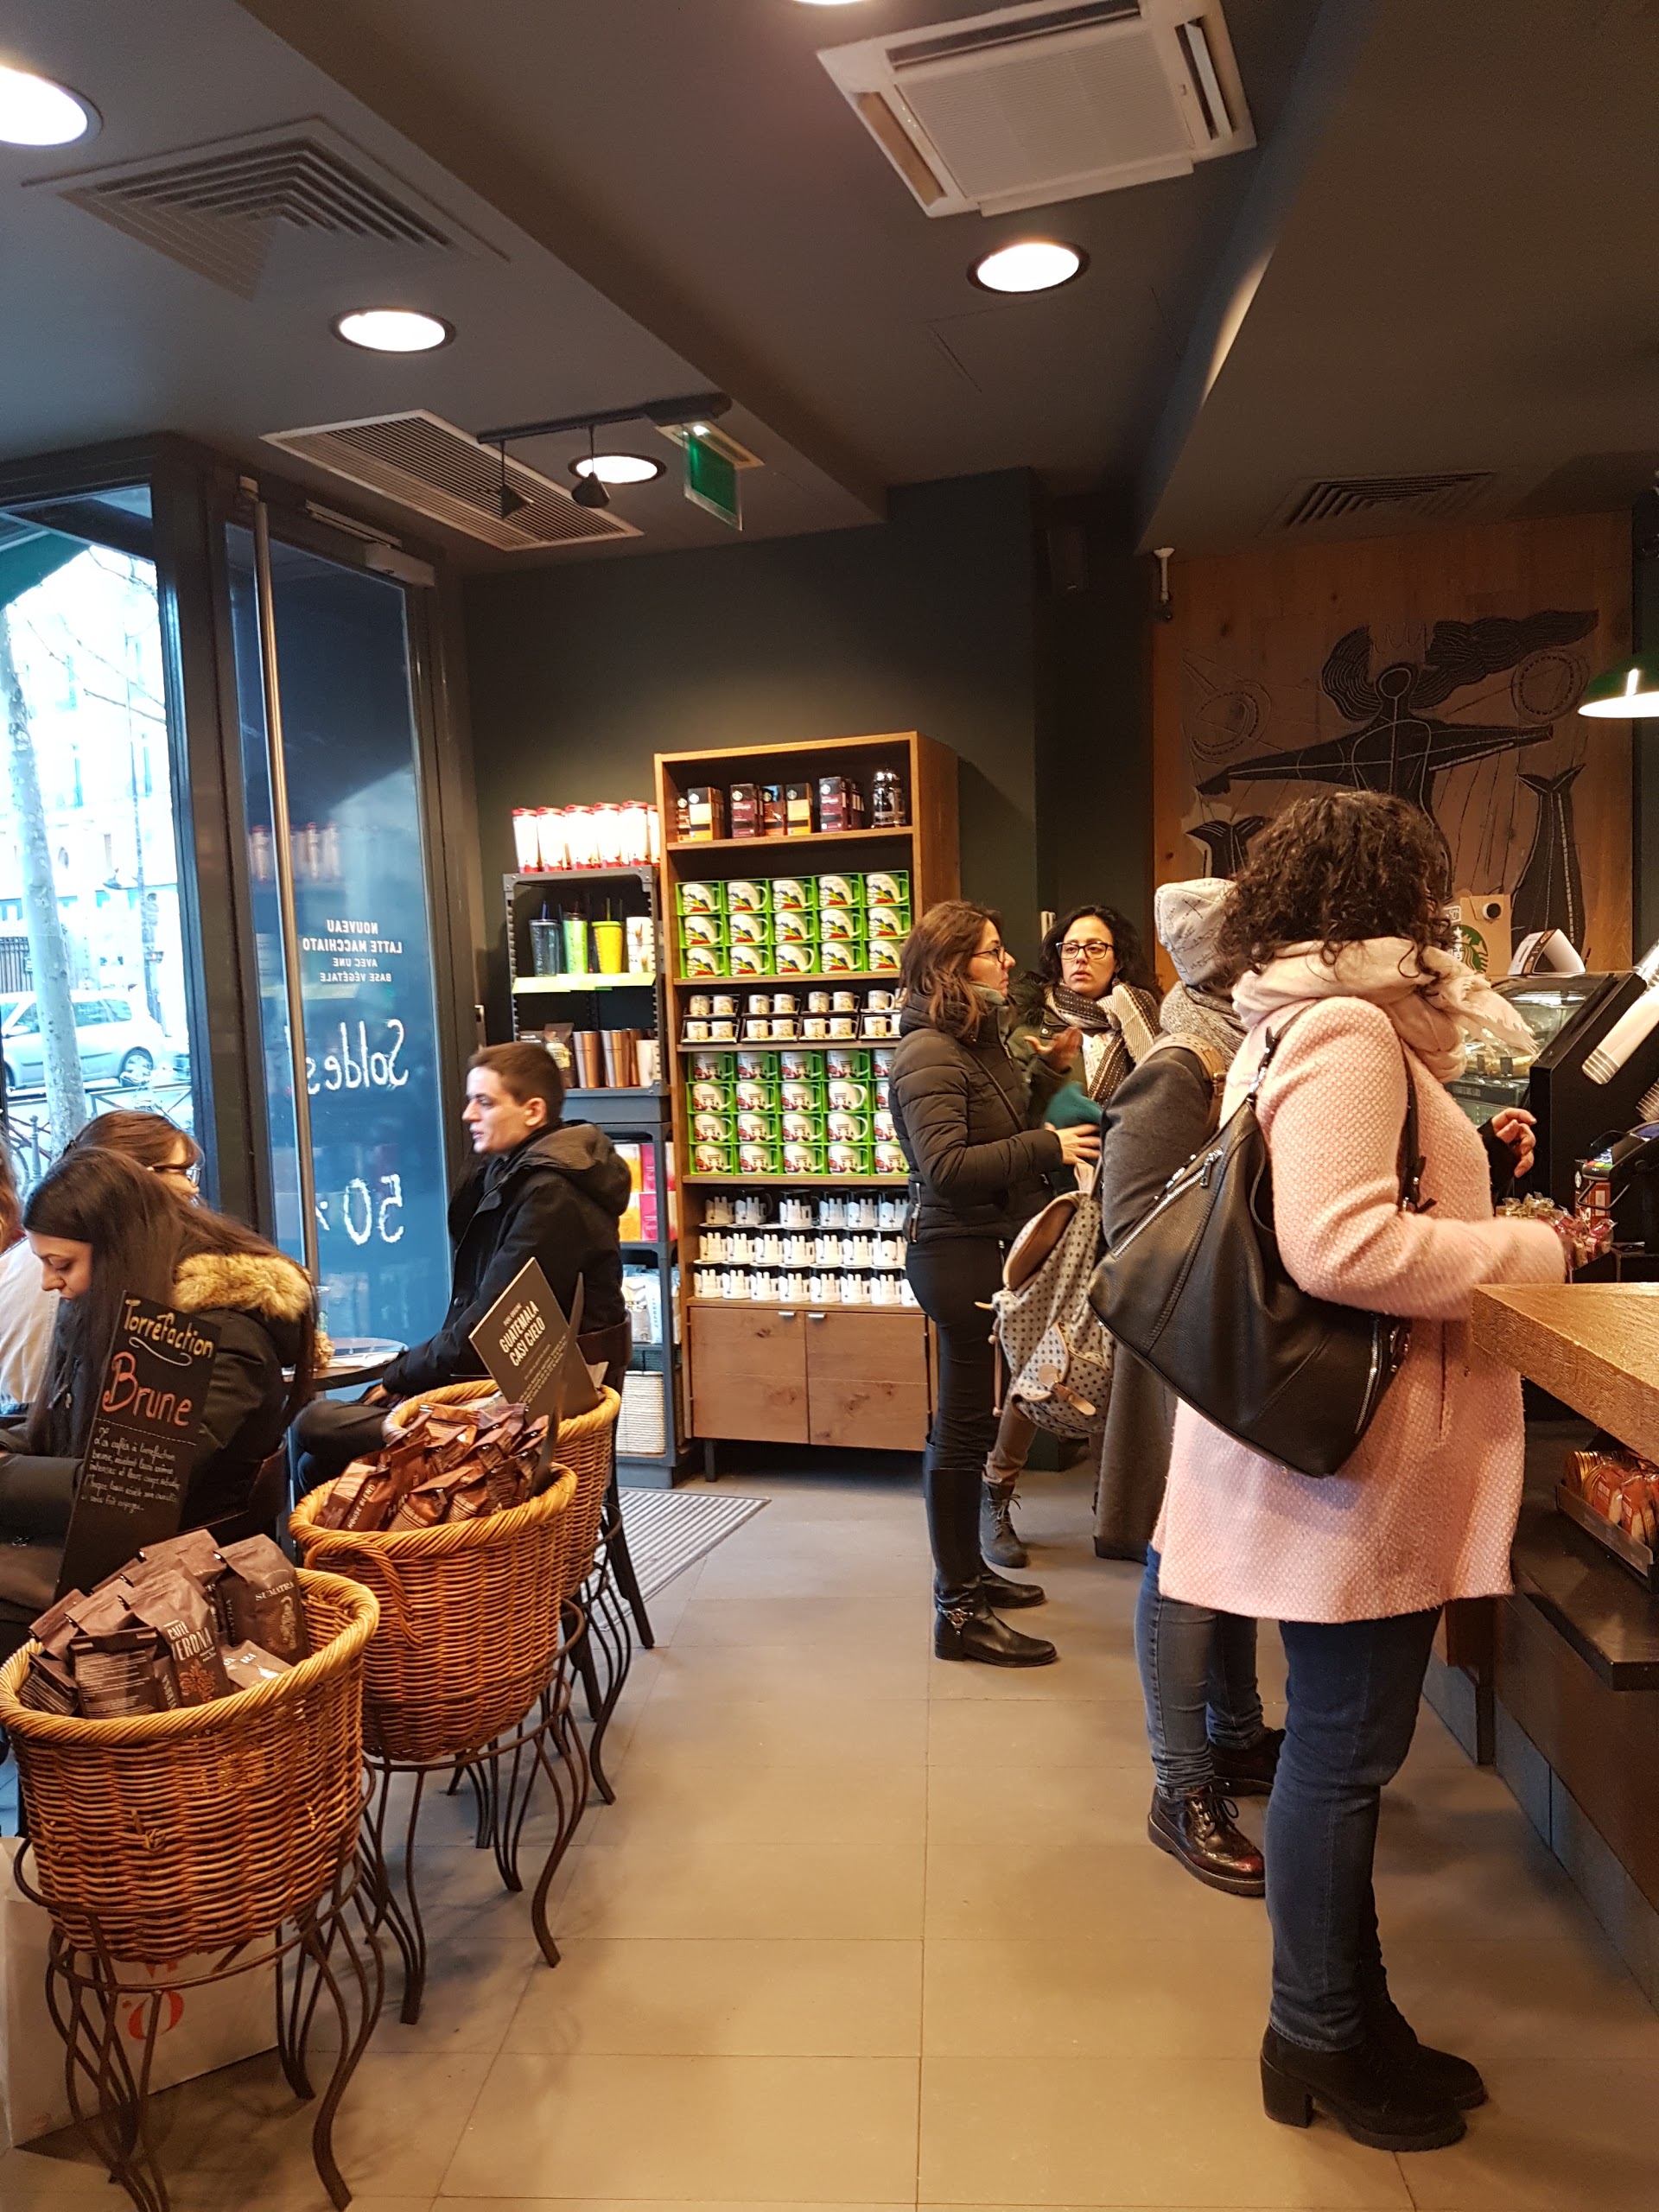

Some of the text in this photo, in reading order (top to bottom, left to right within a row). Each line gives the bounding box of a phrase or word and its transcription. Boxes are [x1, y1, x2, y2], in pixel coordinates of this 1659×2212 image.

[499, 1300, 539, 1353] GUATEMALA
[509, 1339, 529, 1366] CASI
[524, 1316, 546, 1346] CIELO
[101, 1351, 193, 1427] Brune
[347, 1484, 376, 1529] HOUSE BLEND
[255, 1580, 296, 1601] SUMATRA
